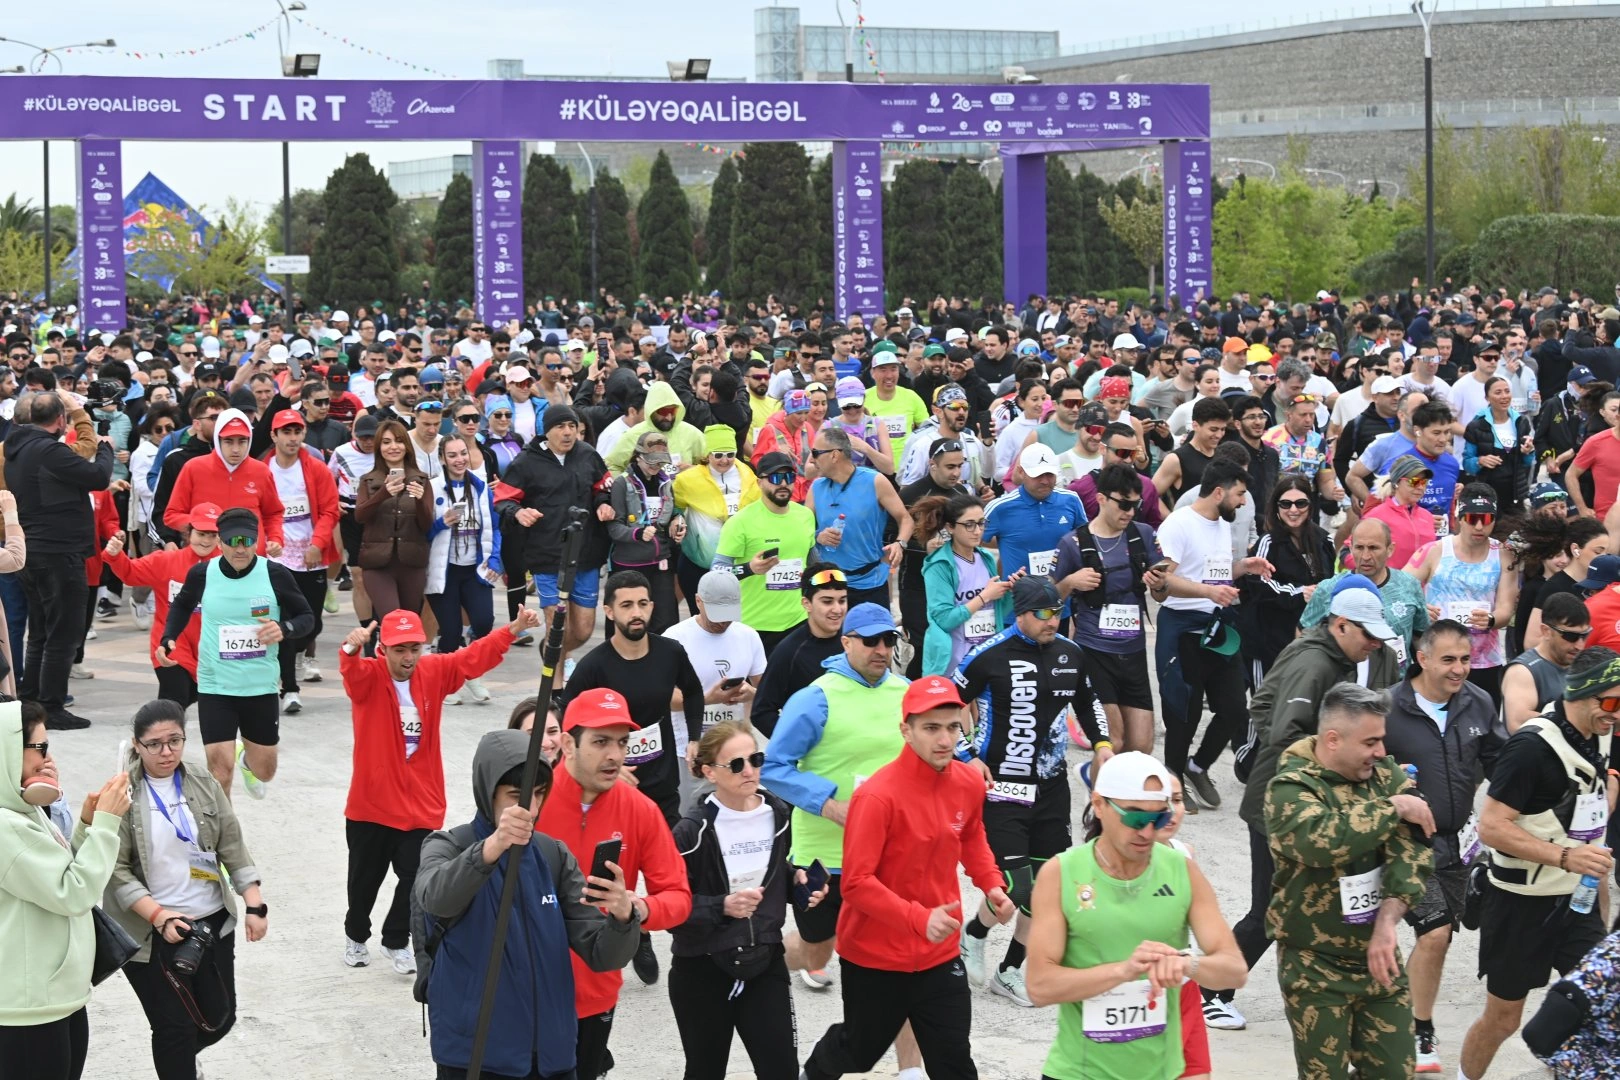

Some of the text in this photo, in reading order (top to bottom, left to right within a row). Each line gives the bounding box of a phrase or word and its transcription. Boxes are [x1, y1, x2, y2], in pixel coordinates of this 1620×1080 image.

[24, 95, 181, 113] #KÜLƏYƏQALİBGƏL
[203, 93, 346, 121] START
[559, 94, 807, 124] #KÜLƏYƏQALİBGƏL
[772, 570, 800, 582] 17425
[1209, 568, 1229, 578] 17199
[1105, 616, 1136, 628] 17509
[225, 638, 261, 650] 16743
[703, 710, 733, 722] 11615
[1105, 1004, 1147, 1026] 5171
